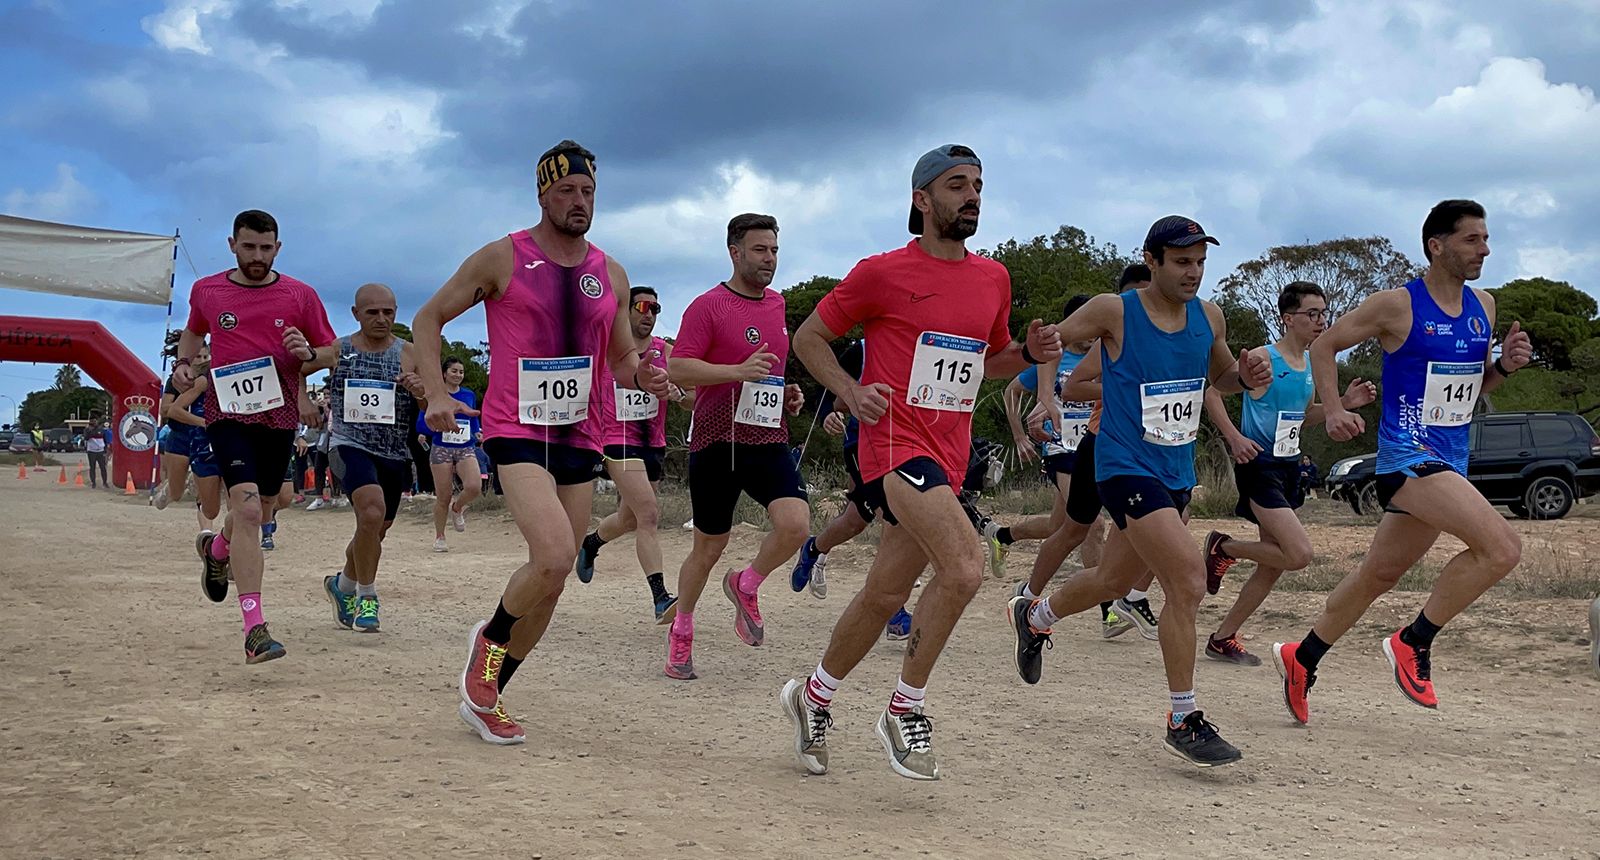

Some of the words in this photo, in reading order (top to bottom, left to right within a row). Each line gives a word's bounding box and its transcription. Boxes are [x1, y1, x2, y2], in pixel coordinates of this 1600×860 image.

[934, 358, 973, 384] 115
[231, 375, 263, 397] 107
[538, 378, 578, 400] 108
[1443, 383, 1473, 403] 141
[360, 393, 380, 407] 93
[625, 393, 651, 406] 126
[753, 390, 778, 408] 139
[1160, 400, 1193, 423] 104
[1073, 424, 1089, 436] 13
[1289, 427, 1299, 440] 6
